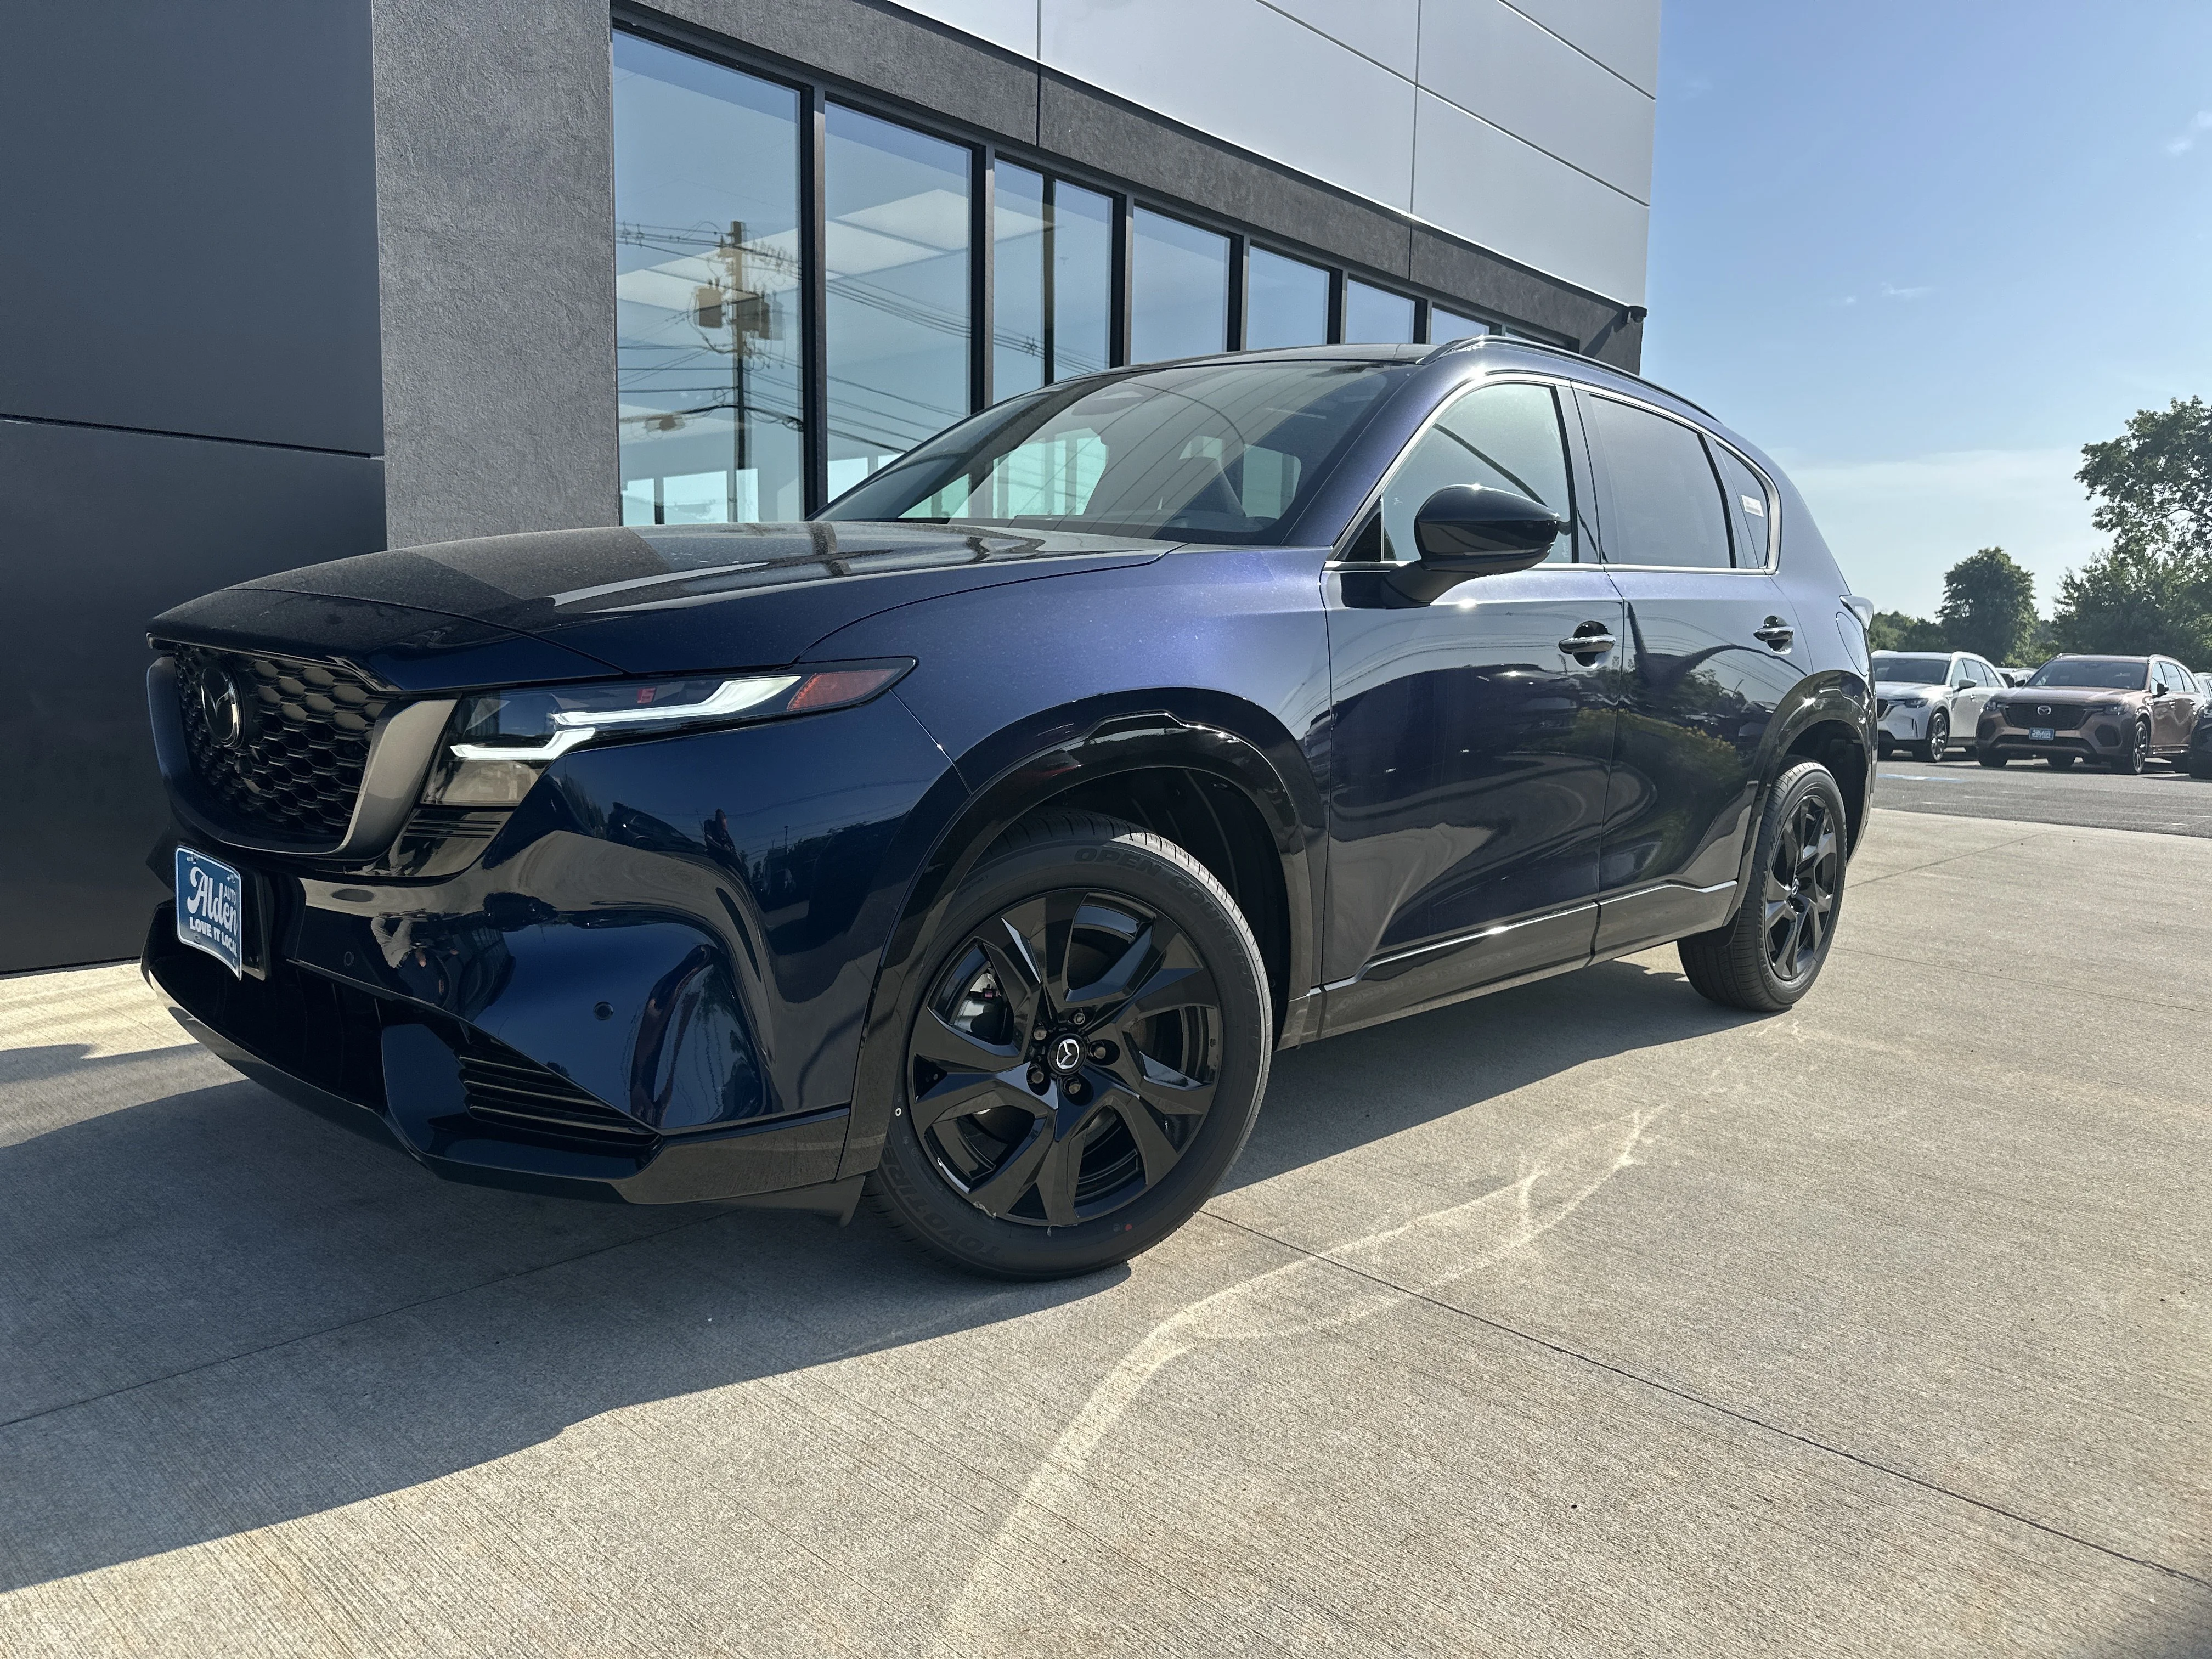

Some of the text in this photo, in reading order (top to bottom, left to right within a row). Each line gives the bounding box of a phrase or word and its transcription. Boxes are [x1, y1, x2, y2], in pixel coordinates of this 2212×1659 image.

[187, 867, 237, 936] Alden
[224, 885, 236, 905] AUTO
[189, 917, 238, 958] LOVE IT LOCAL
[1074, 848, 1162, 876] OPEN
[1167, 876, 1255, 994] COUNTRY
[923, 1211, 1001, 1257] TOYO
